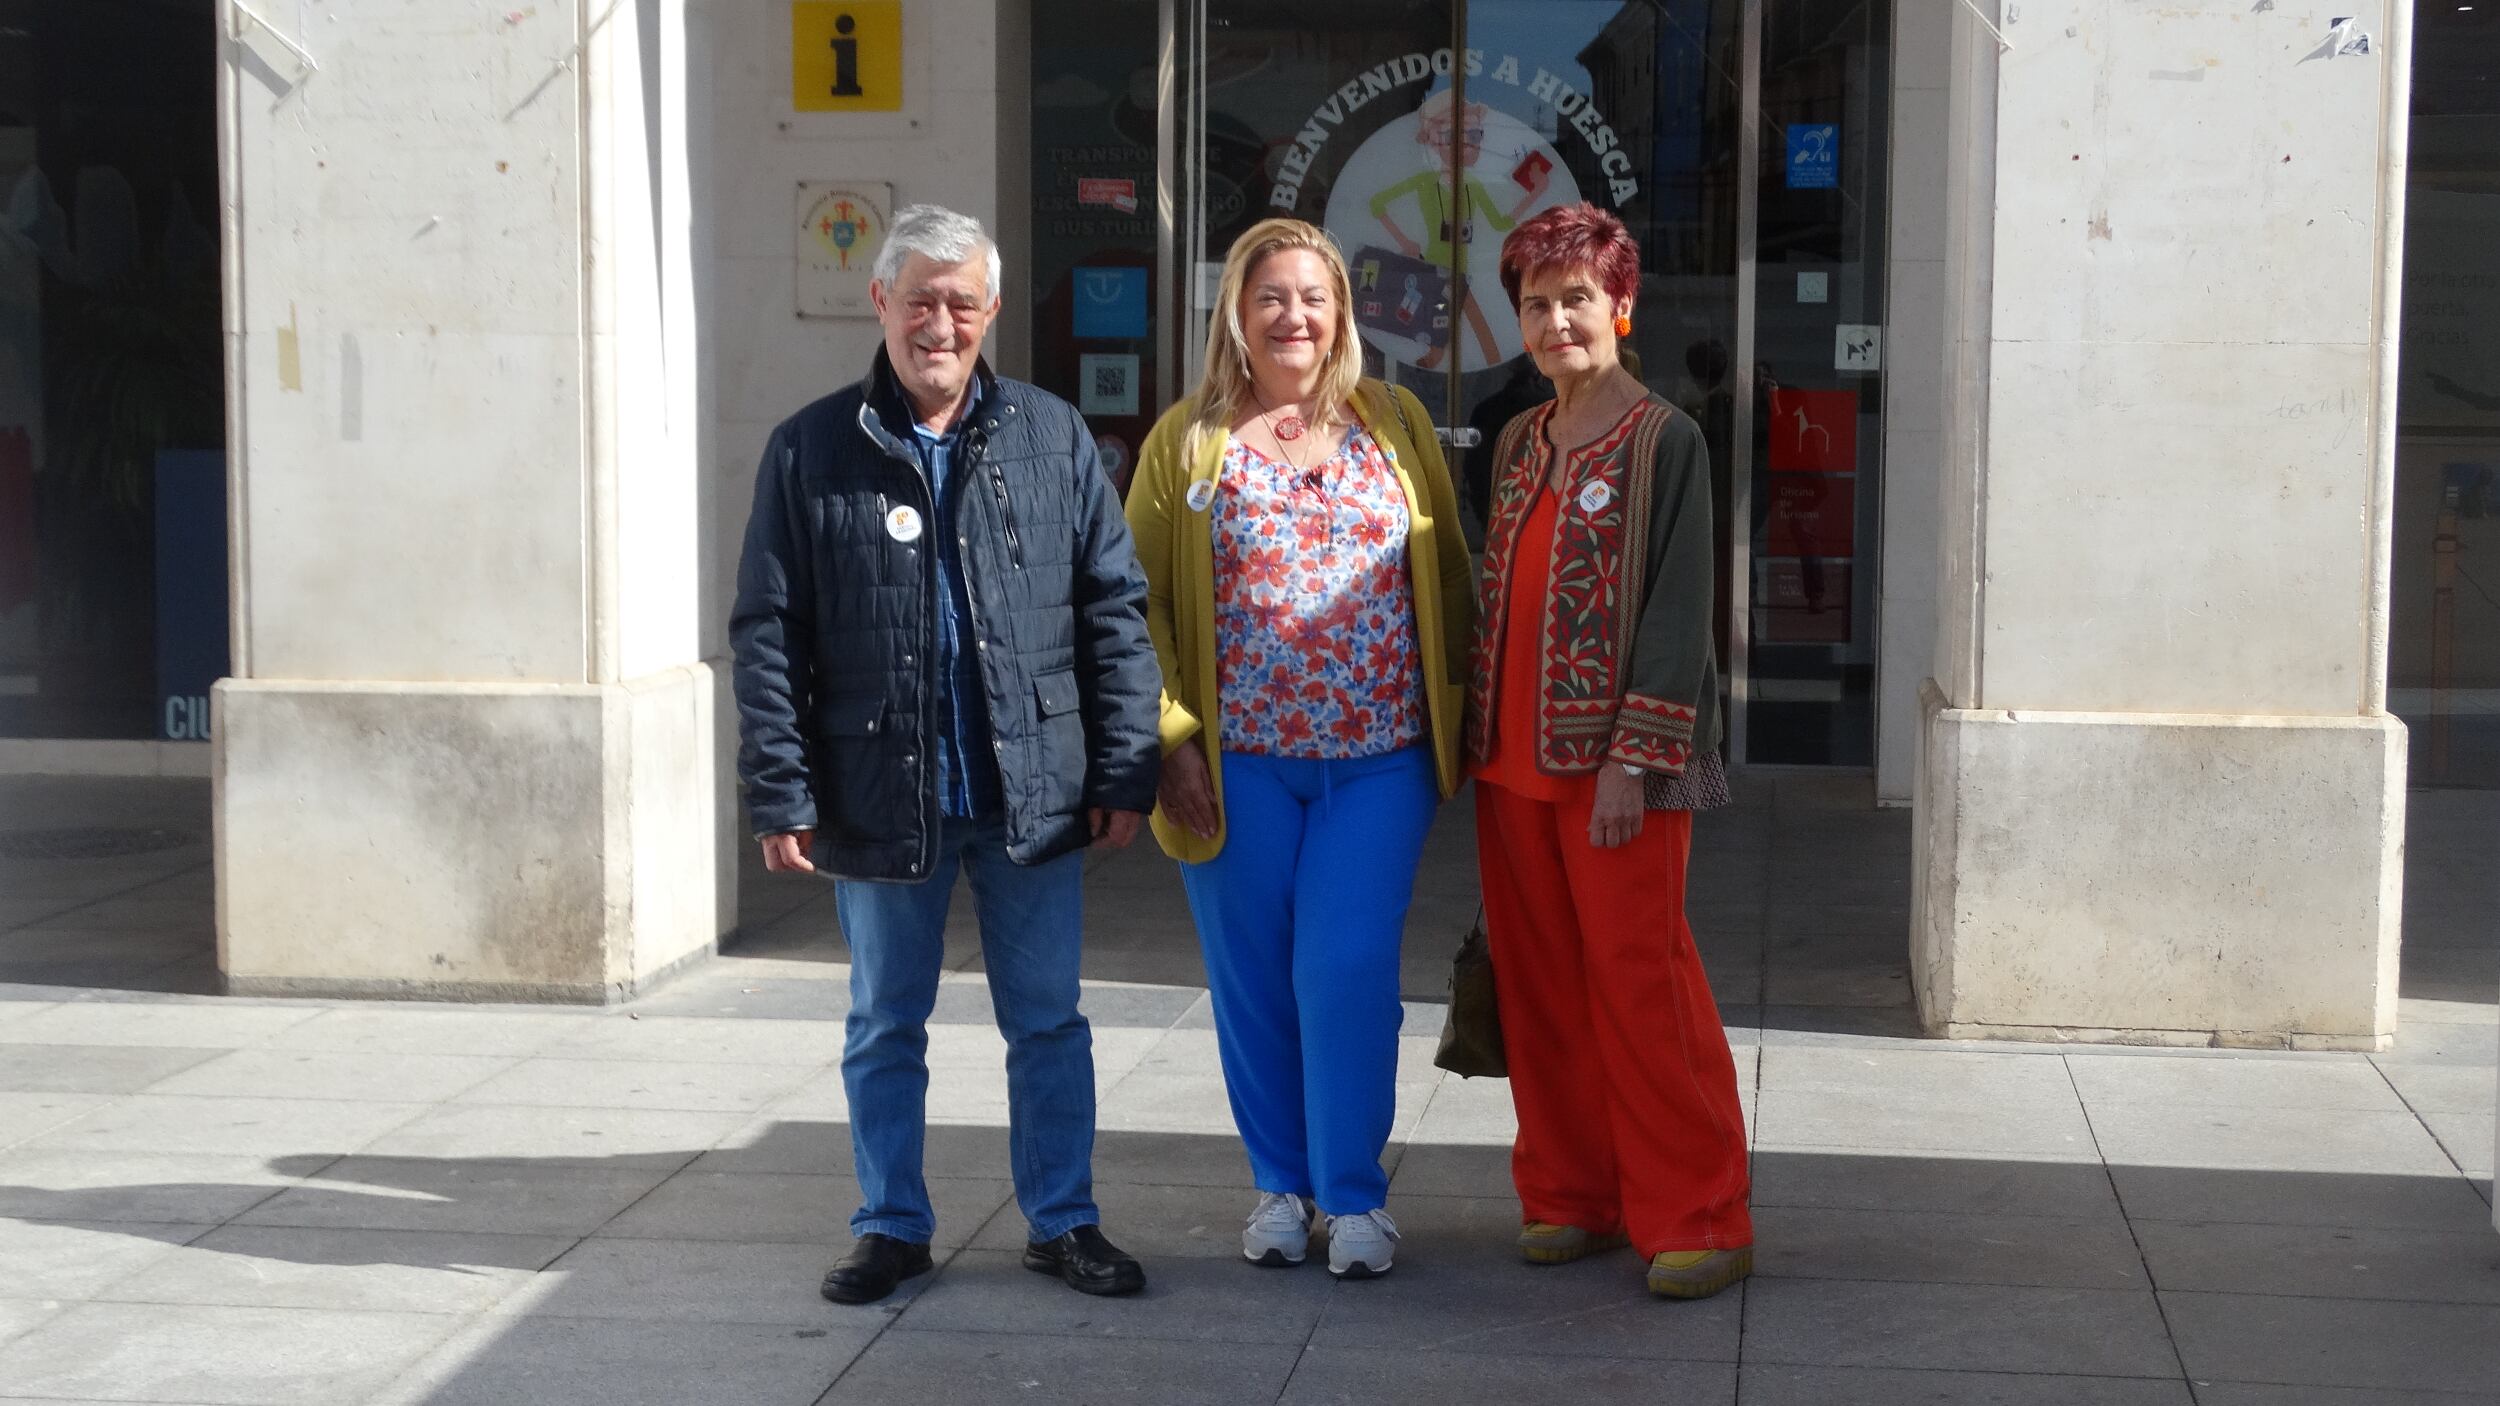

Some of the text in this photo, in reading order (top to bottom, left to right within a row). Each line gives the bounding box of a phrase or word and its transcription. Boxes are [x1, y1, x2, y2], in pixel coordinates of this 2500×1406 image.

[1269, 48, 1640, 212] BIENVENIDOS A HUESCA
